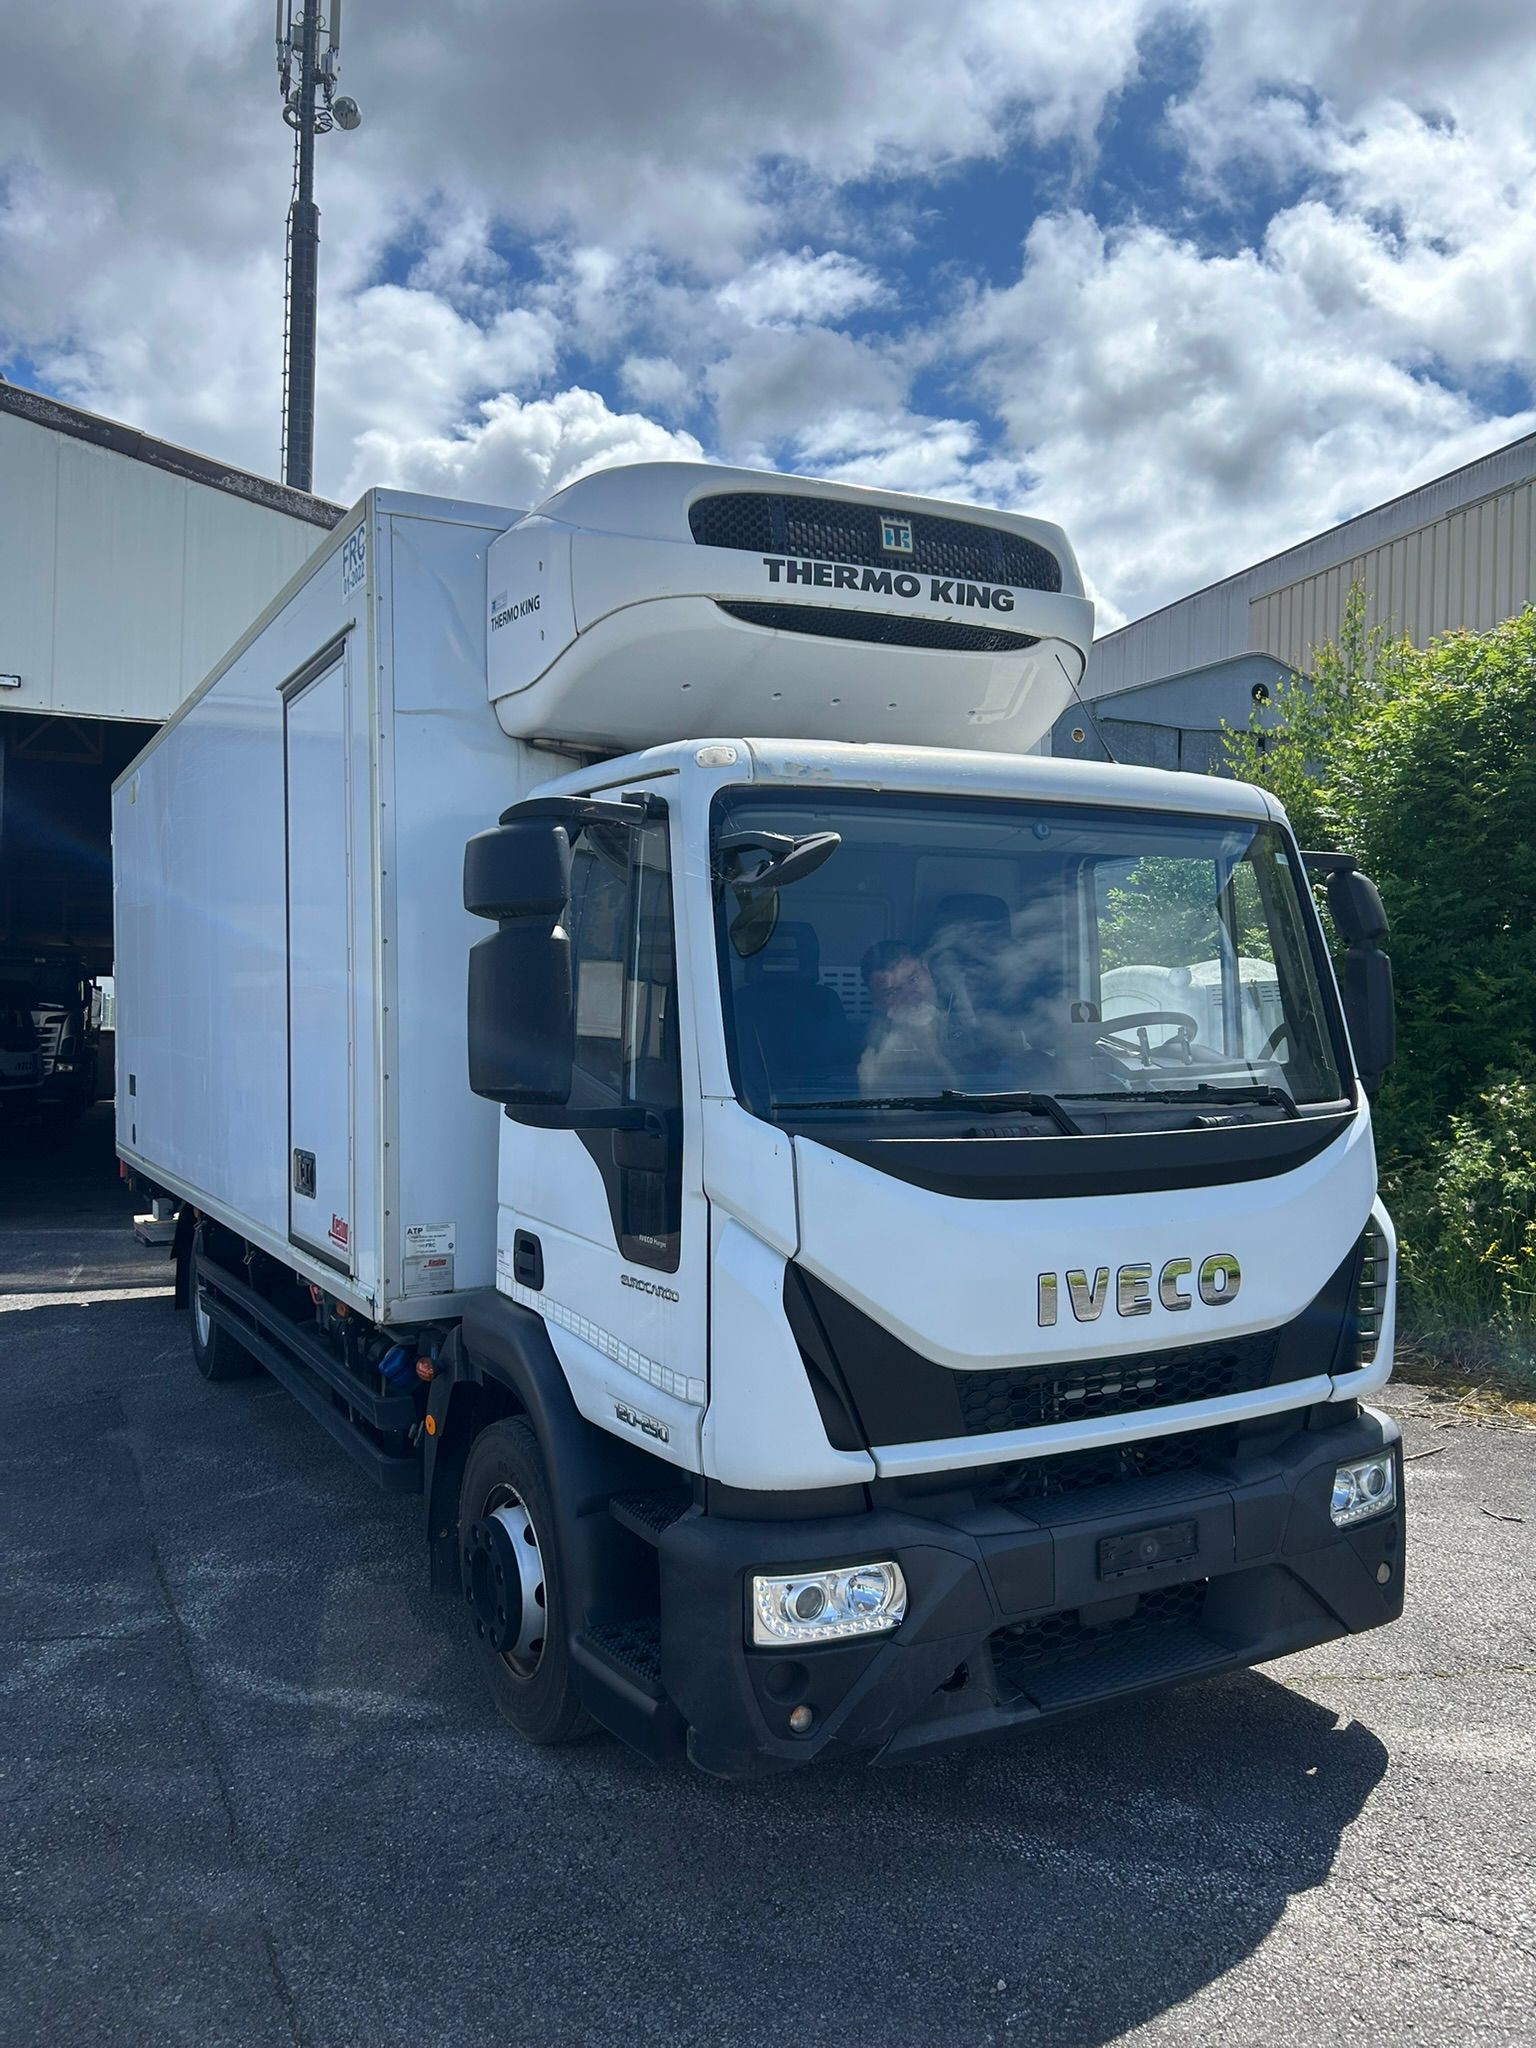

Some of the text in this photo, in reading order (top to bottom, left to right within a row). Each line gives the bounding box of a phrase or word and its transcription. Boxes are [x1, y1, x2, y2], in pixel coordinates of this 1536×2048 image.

[342, 525, 366, 577] FRC
[762, 557, 1016, 613] THERMO KING
[490, 604, 520, 633] THERMO
[519, 593, 541, 617] KING
[406, 1226, 424, 1236] ATP
[620, 1273, 680, 1303] EUROCARGO
[1037, 1252, 1242, 1327] IVECO
